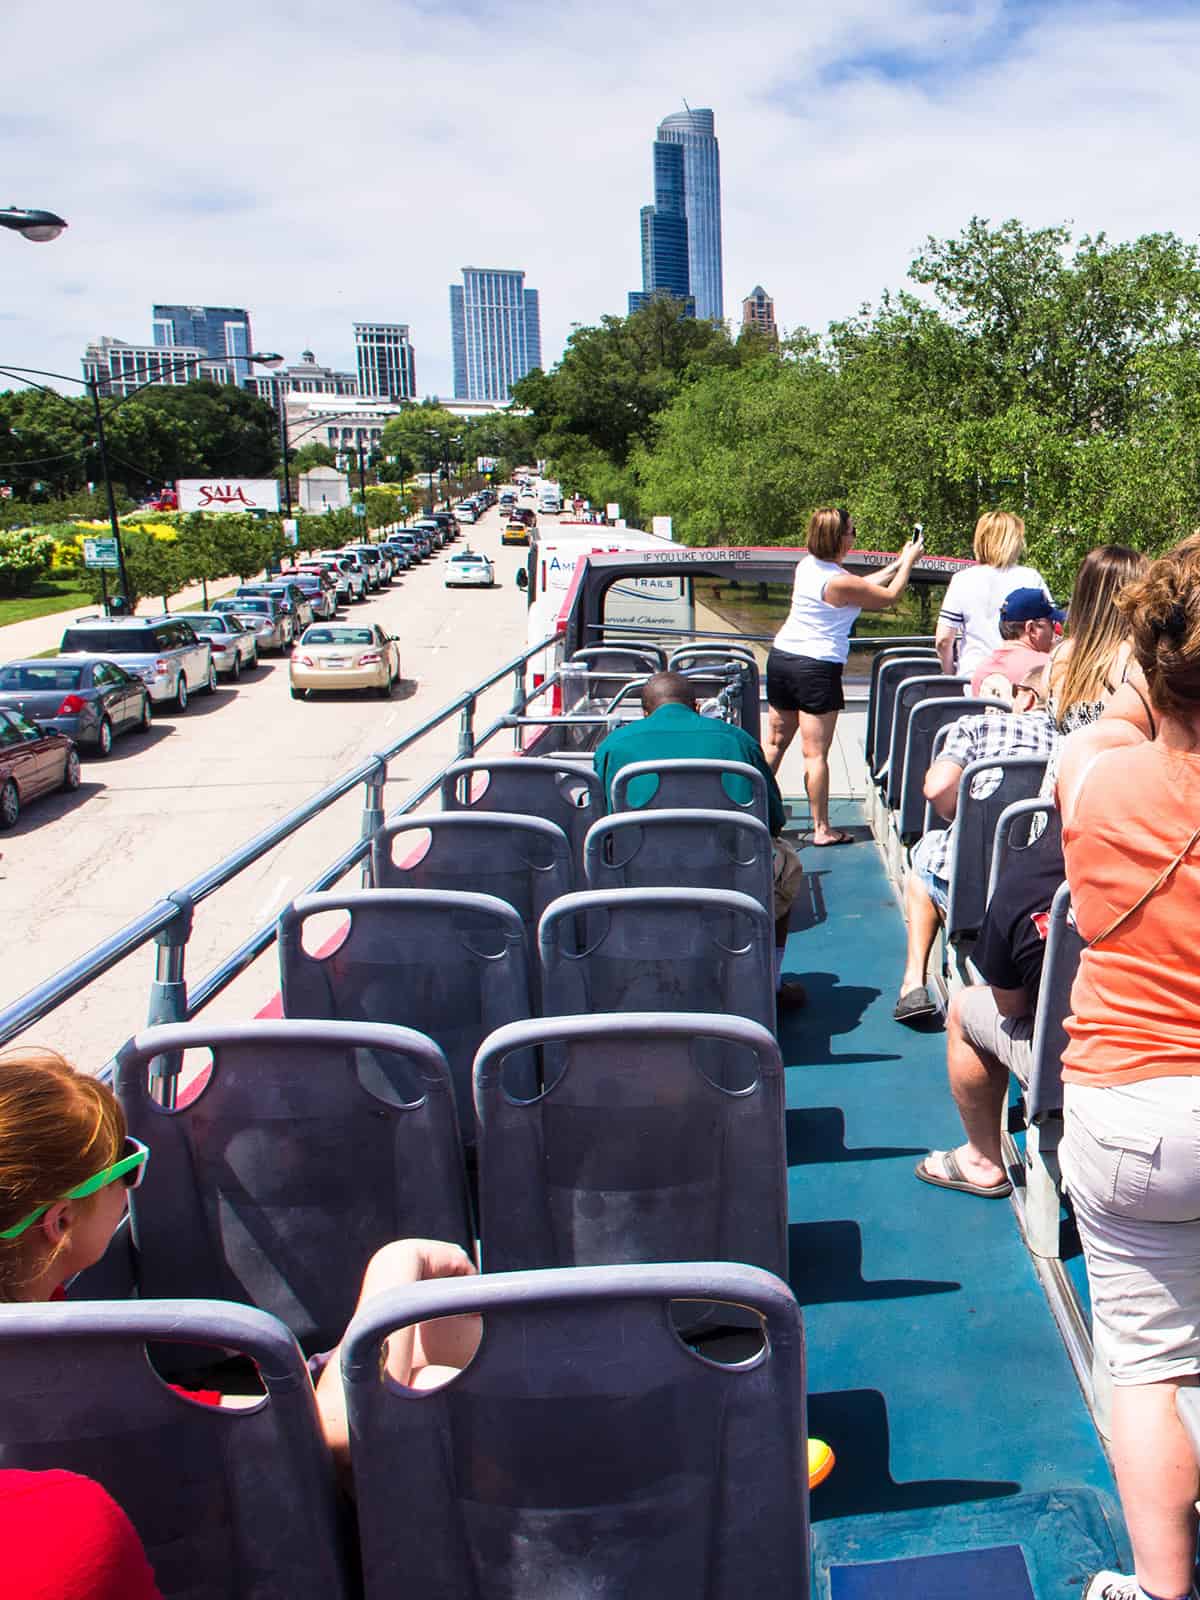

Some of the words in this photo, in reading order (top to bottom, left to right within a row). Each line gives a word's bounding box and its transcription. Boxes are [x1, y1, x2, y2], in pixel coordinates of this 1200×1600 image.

[198, 484, 256, 506] SAIA
[643, 552, 652, 561] IF
[654, 552, 674, 561] YOU
[676, 551, 697, 561] LIKE
[699, 551, 726, 561] YOUR
[728, 550, 751, 560] RIDE
[863, 554, 882, 565] YOU
[920, 559, 946, 570] YOUR
[948, 561, 975, 572] GUID
